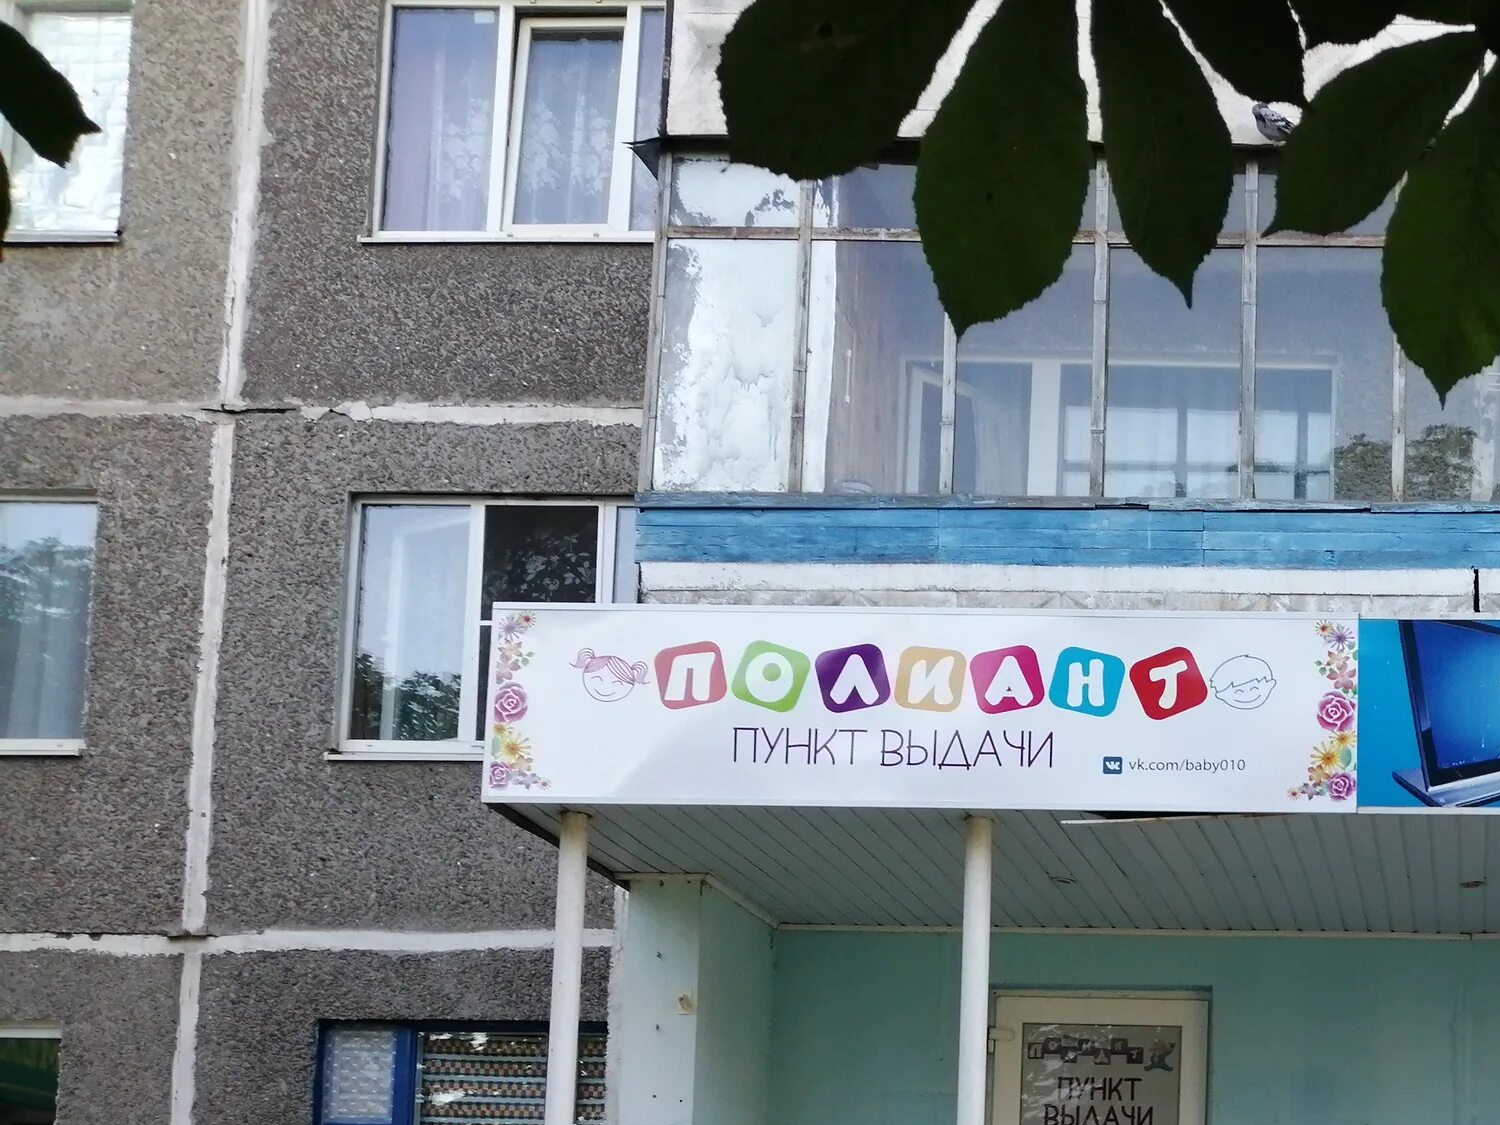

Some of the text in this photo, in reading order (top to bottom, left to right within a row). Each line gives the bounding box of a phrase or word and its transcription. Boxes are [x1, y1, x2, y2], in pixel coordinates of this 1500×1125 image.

[660, 649, 1198, 713] ПОЛИАНТ
[733, 728, 1054, 772] ПУНКТ ВЫДАЧИ
[1128, 757, 1247, 774] vk.com/baby010
[1058, 1076, 1143, 1101] ПУНКТ
